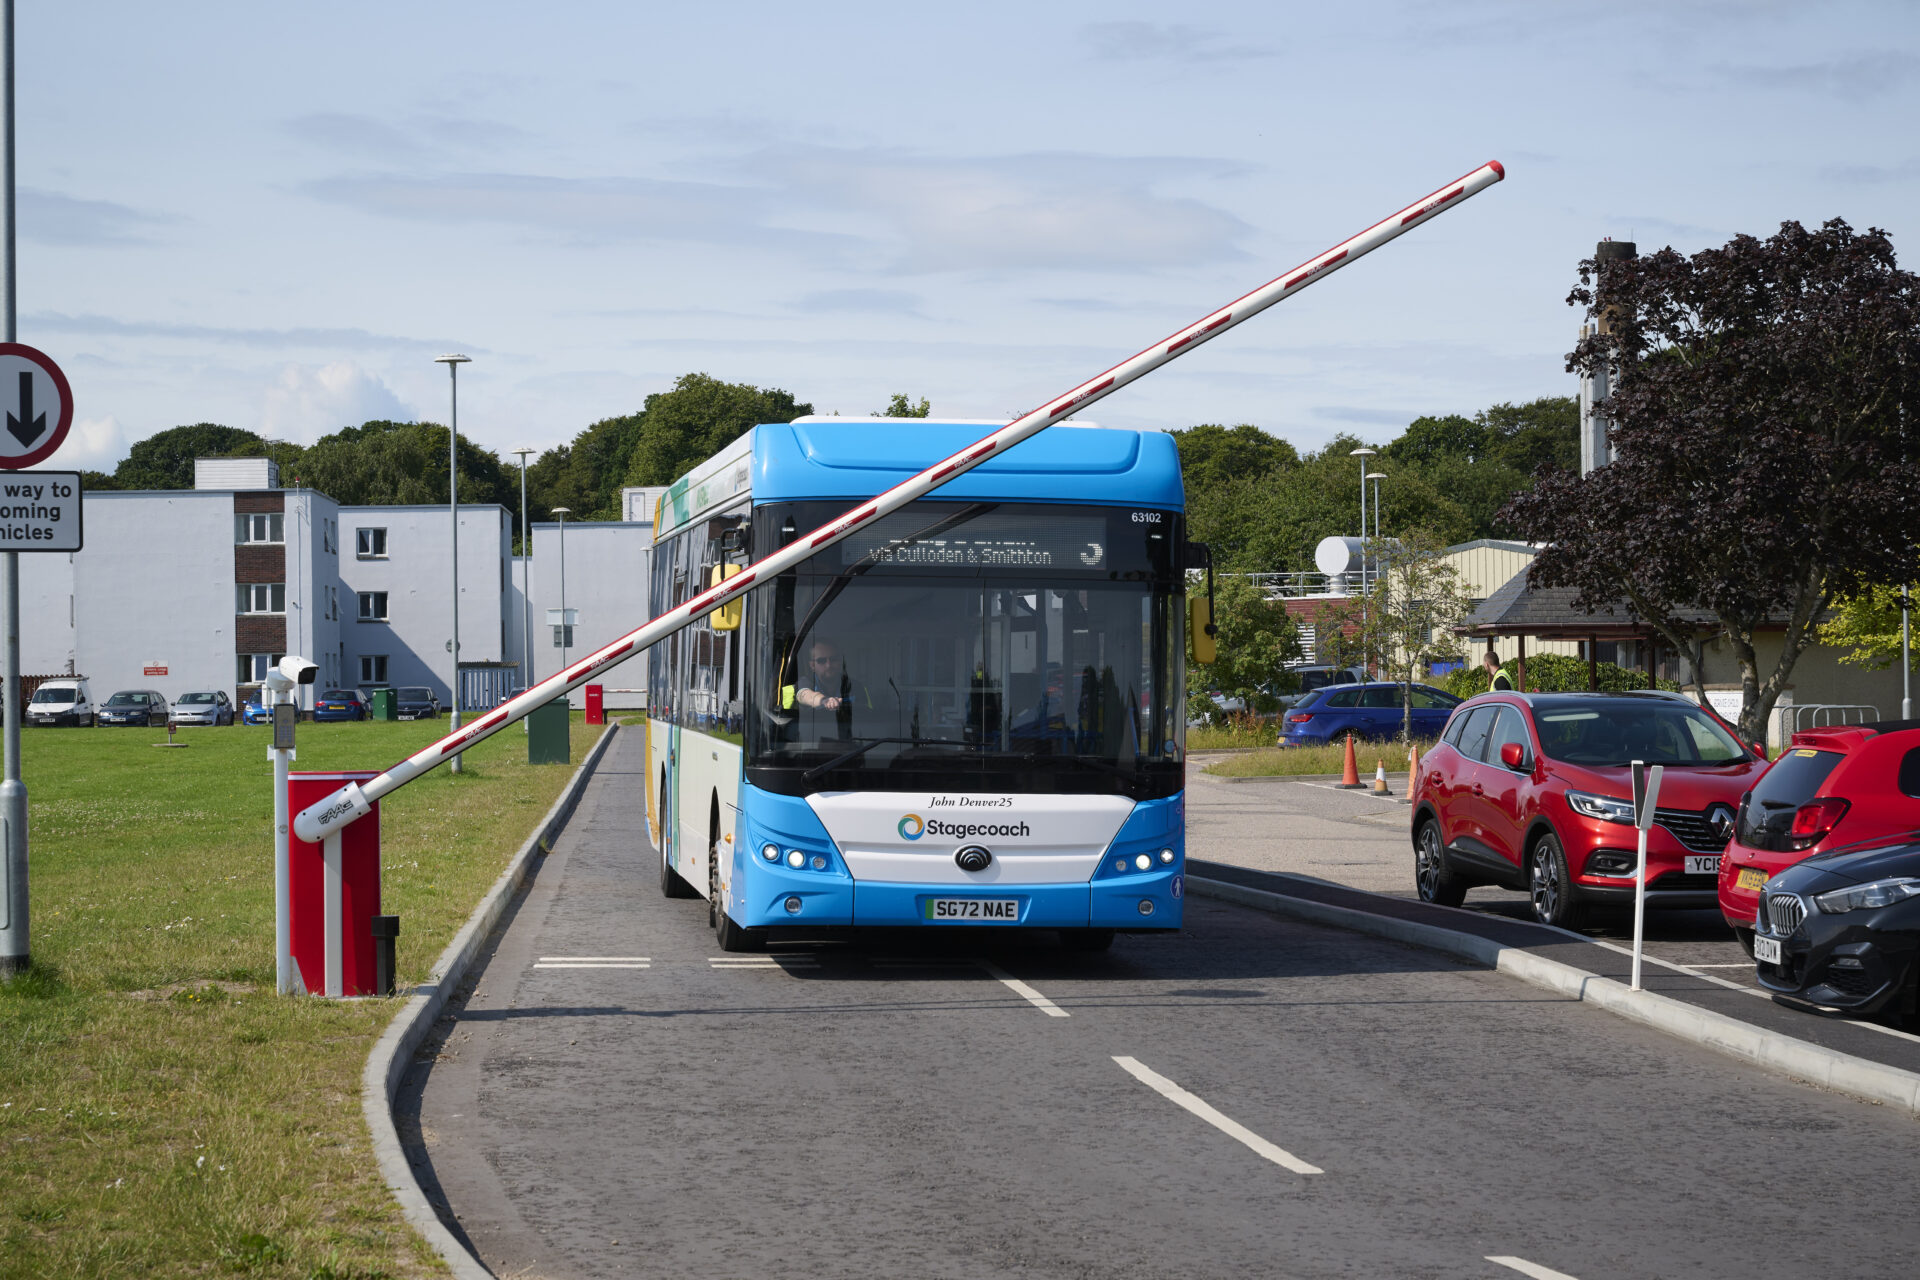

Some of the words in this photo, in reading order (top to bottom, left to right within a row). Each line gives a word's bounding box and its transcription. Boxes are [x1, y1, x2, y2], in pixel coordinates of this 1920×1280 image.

[4, 485, 44, 500] way
[51, 482, 72, 498] to
[0, 503, 61, 522] oming
[1131, 512, 1162, 524] 63102
[897, 547, 963, 563] Culloden
[967, 548, 978, 563] &
[981, 549, 1051, 565] Smithton
[928, 796, 956, 809] John
[959, 797, 1013, 807] Denver25
[318, 800, 354, 825] FAAC
[926, 819, 1030, 839] Stagecoach
[936, 901, 979, 917] SG72
[983, 902, 1016, 918] NAE
